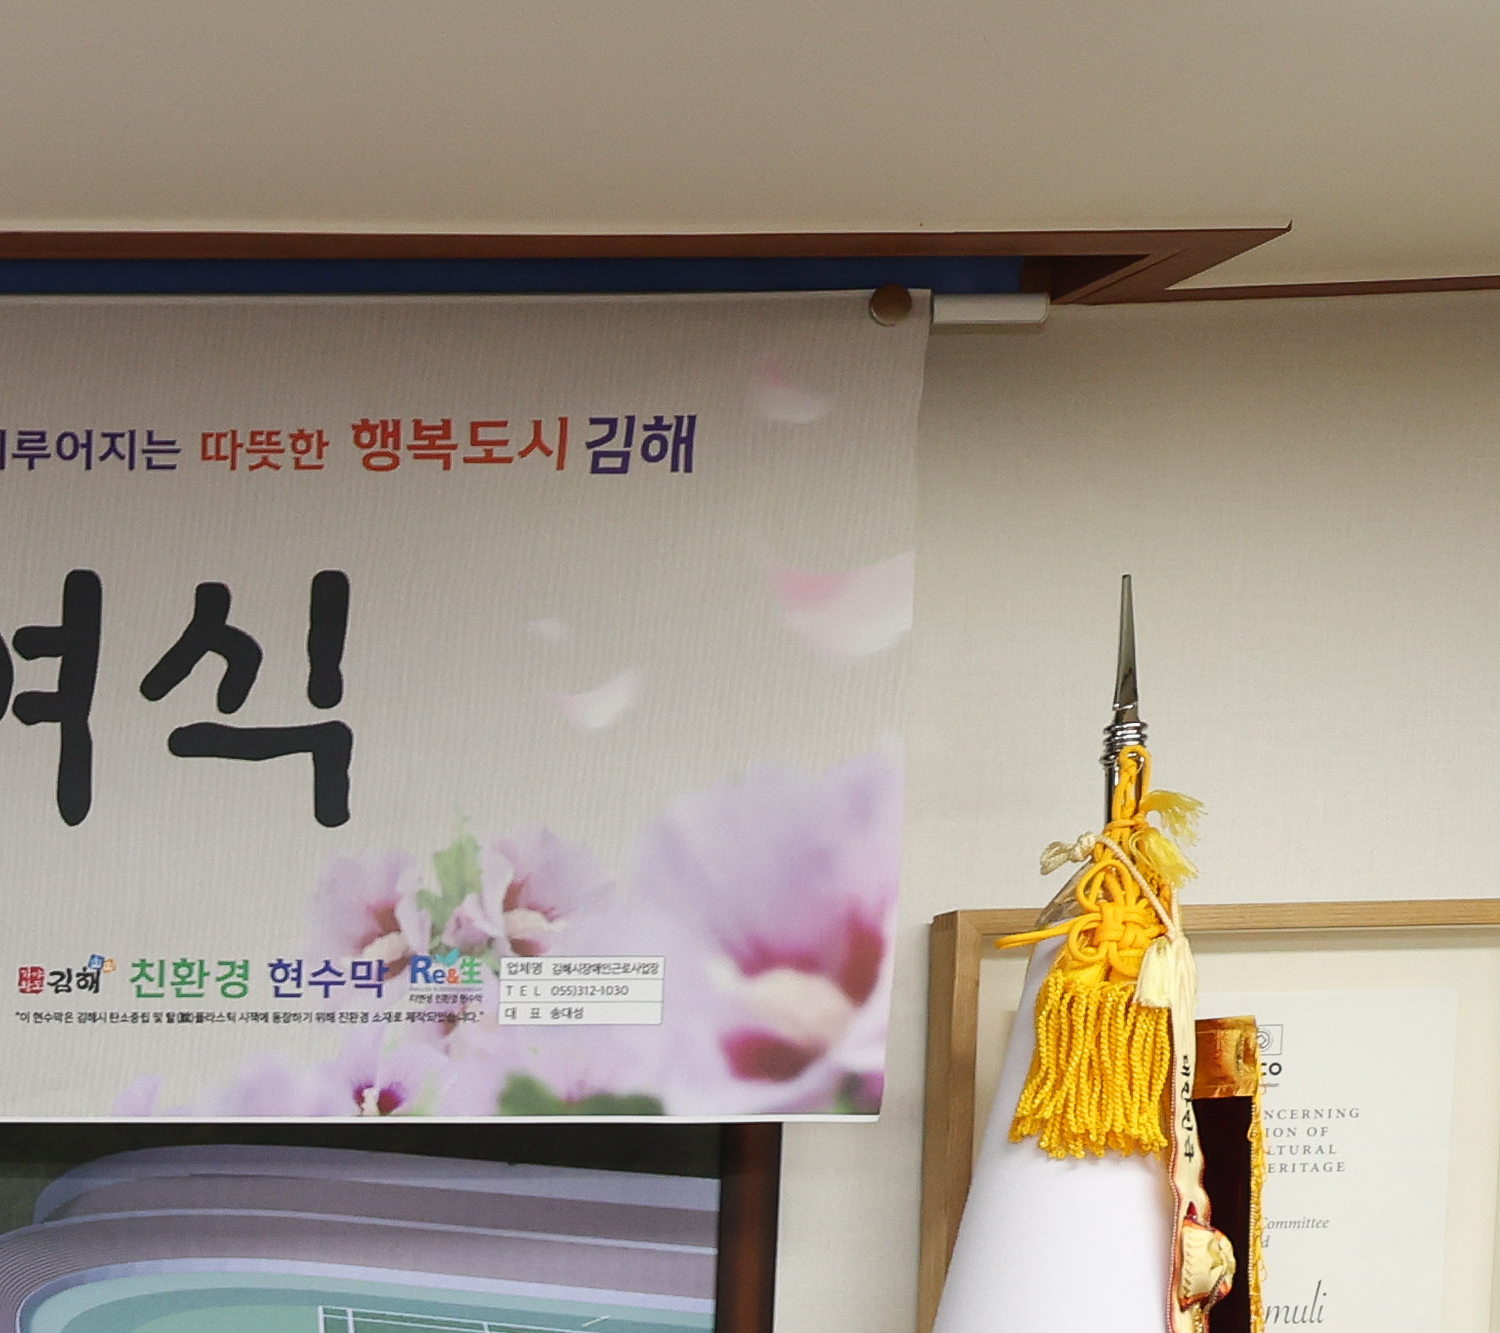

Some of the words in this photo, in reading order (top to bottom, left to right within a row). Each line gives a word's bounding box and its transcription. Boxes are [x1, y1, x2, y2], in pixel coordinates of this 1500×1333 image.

[200, 428, 330, 472] 따뜻한
[351, 416, 570, 472] 행복도시
[585, 414, 698, 475] 김해
[130, 958, 251, 999] 친환경
[267, 957, 390, 999] 현수막
[550, 985, 630, 997] 055)312-1030
[1264, 1108, 1361, 1120] NCERNING
[1306, 1126, 1330, 1137] OF
[1267, 1144, 1338, 1155] LTURAL
[1267, 1162, 1346, 1173] ERITAGE
[1264, 1280, 1327, 1324] muli
